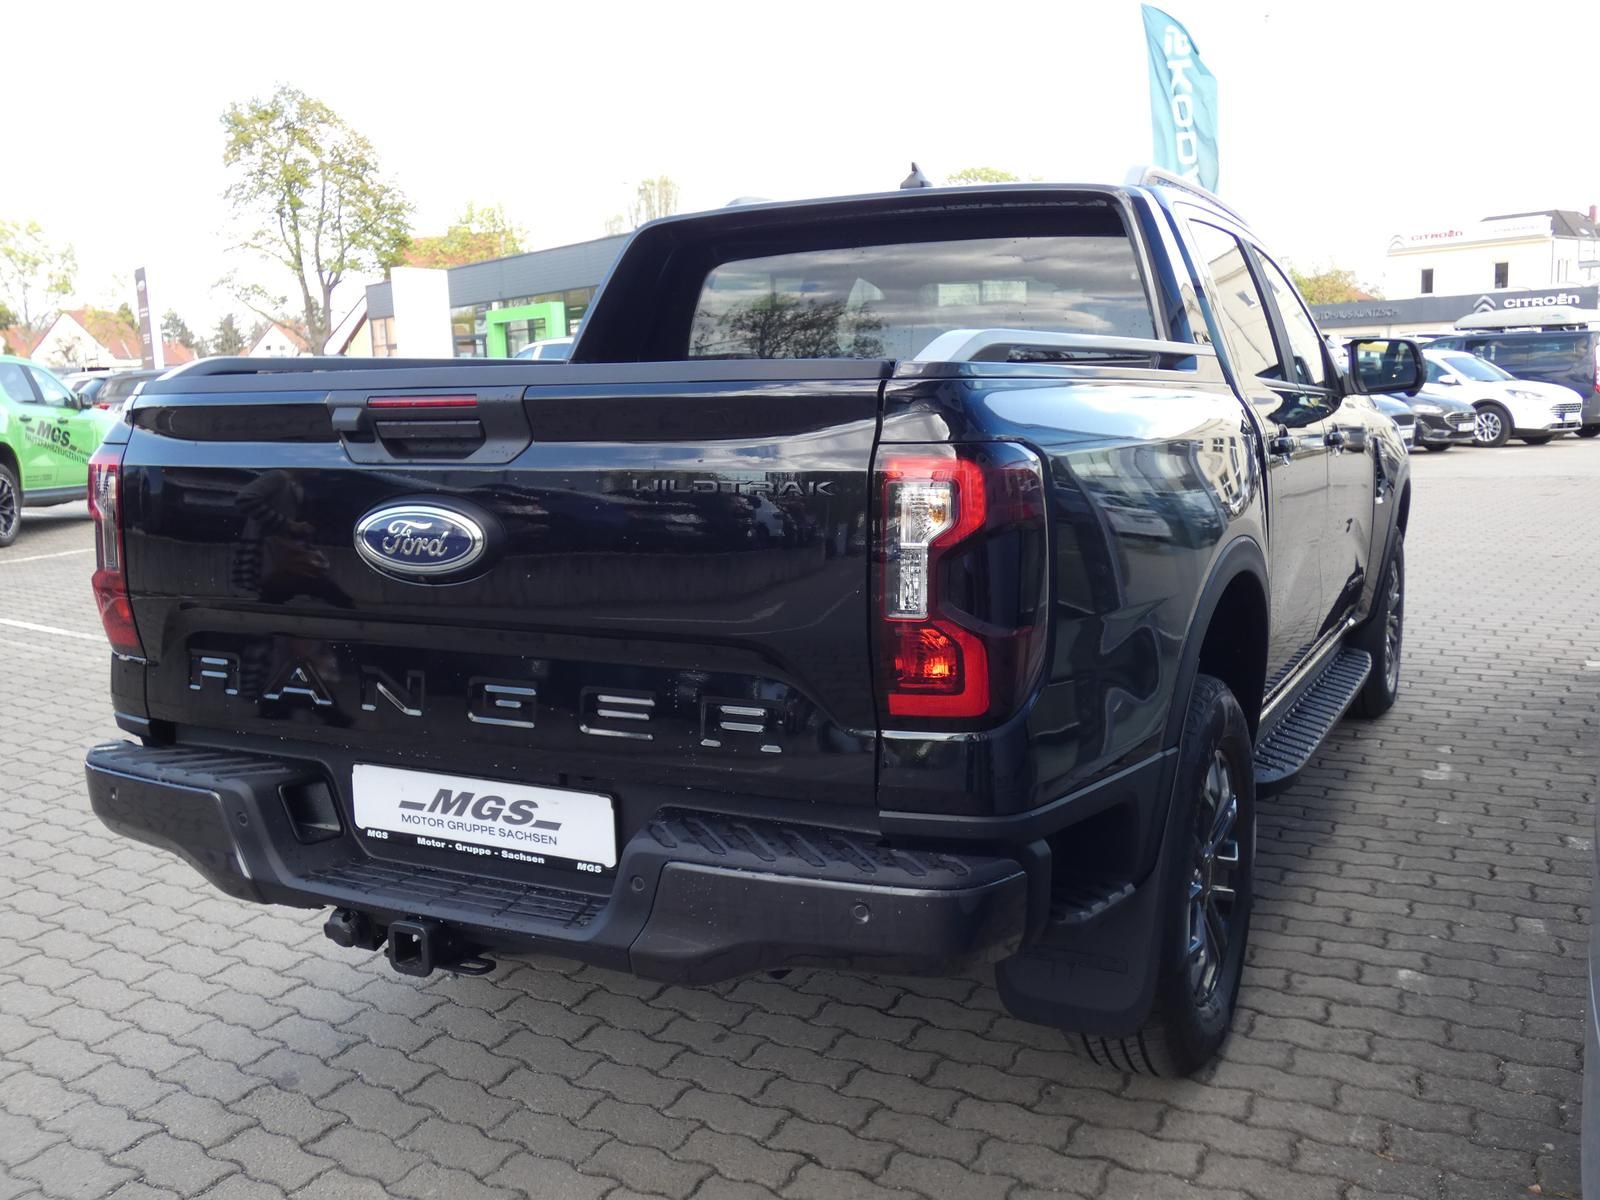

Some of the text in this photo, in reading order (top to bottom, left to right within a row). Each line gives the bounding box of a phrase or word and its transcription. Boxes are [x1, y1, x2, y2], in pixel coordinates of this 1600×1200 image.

[37, 421, 71, 447] MGS
[632, 479, 835, 496] WILDTRAK
[382, 519, 449, 557] Ford
[188, 649, 783, 753] RANGER
[426, 788, 539, 826] MGS
[367, 829, 389, 840] MGS
[401, 814, 558, 846] MOTOR GRUPPE SACHSEN
[416, 837, 446, 849] Motor
[455, 843, 491, 856] Gruppe
[501, 850, 545, 864] Sachsen
[577, 862, 602, 874] MGS
